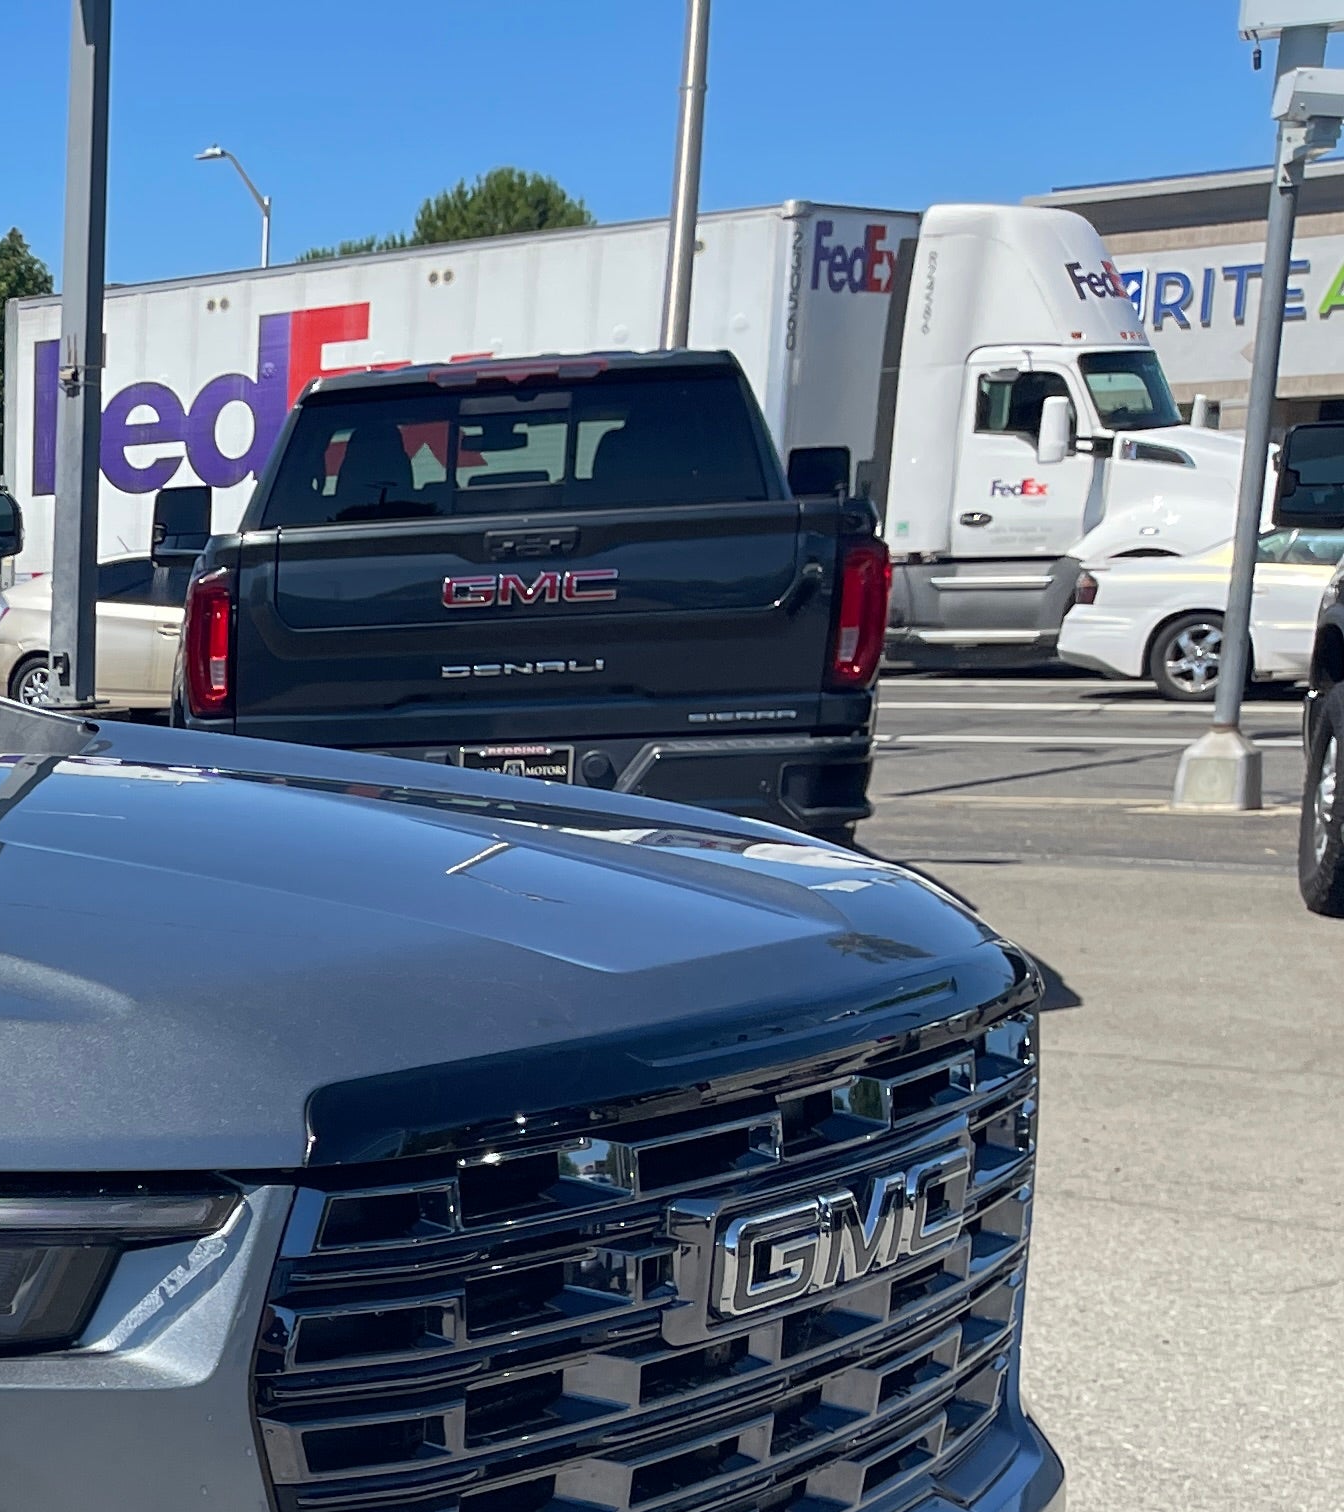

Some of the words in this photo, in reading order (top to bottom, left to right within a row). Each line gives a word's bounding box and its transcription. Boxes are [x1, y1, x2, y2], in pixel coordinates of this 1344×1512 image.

[1064, 260, 1128, 300] FedE
[1153, 260, 1310, 331] RITE
[32, 302, 490, 495] edE
[991, 478, 1047, 496] FedEx
[442, 568, 618, 609] GMC
[441, 658, 604, 678] DENALI
[688, 709, 797, 722] SIERRA
[488, 746, 545, 756] REDDING
[526, 765, 566, 776] MOTORS
[723, 1148, 969, 1315] GMC
